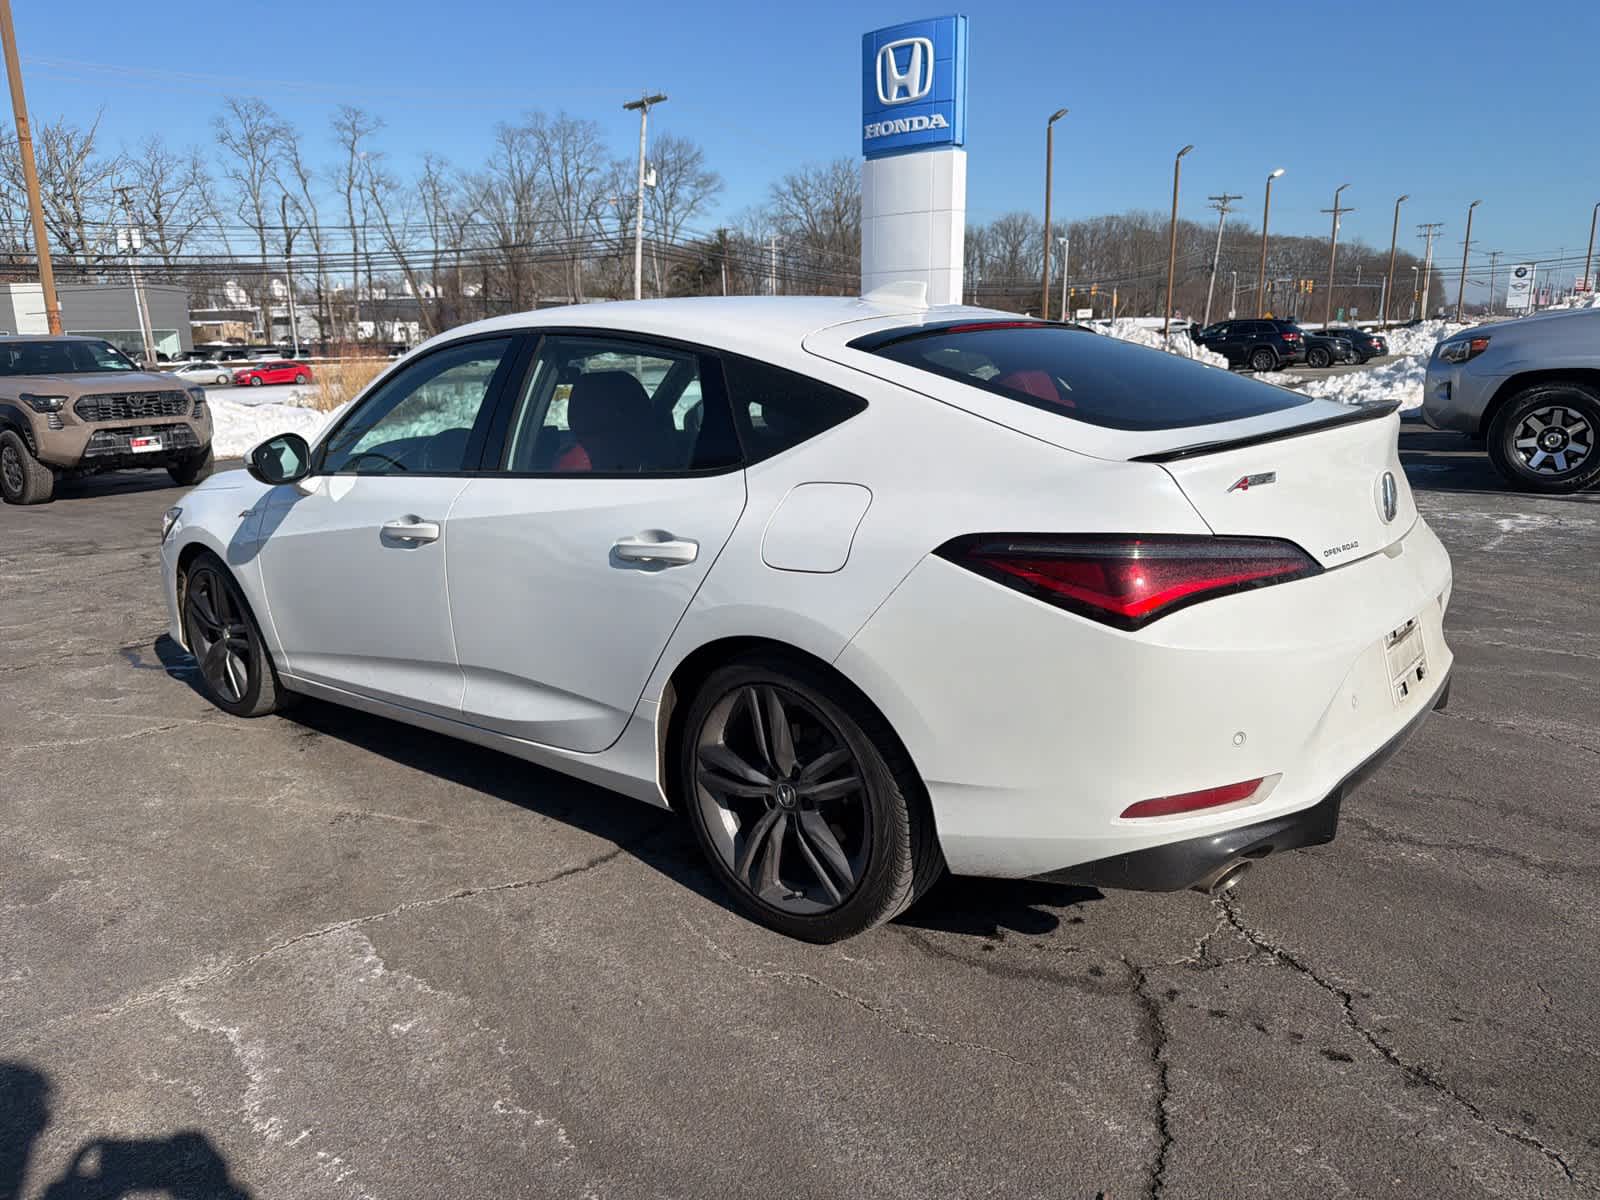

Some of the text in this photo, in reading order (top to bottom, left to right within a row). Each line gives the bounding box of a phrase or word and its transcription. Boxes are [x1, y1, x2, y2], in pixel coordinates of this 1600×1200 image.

[864, 113, 949, 139] HONDA
[1323, 540, 1359, 558] OPEN ROAD
